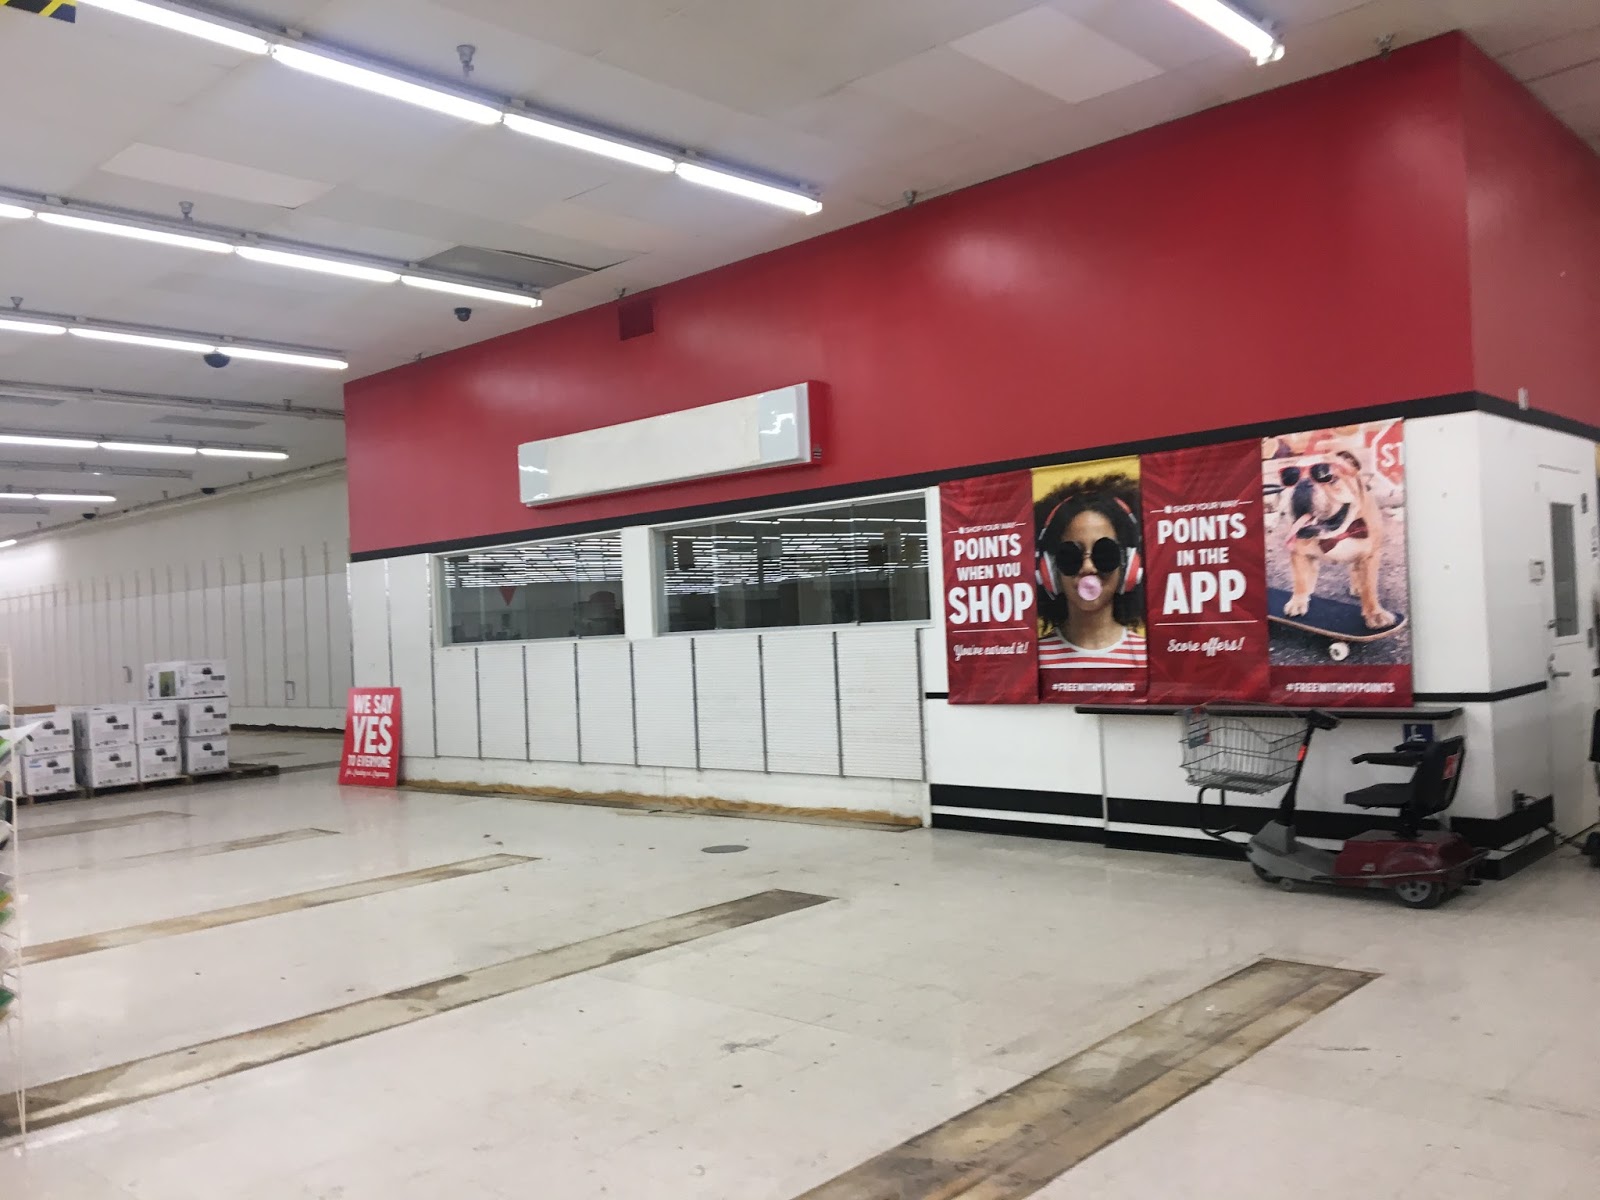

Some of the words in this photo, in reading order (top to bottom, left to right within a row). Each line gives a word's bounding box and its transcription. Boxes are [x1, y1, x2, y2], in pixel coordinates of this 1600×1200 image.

[1172, 504, 1195, 514] SHOP
[1195, 502, 1219, 511] YOUR
[1157, 512, 1247, 545] POINTS
[953, 533, 1022, 562] POINTS
[1177, 549, 1195, 567] IN
[1198, 546, 1230, 566] THE
[956, 564, 994, 581] WHEN
[996, 561, 1021, 578] YOU
[948, 582, 1034, 625] SHOP
[1162, 569, 1247, 615] APP
[1167, 638, 1200, 653] Score
[1200, 636, 1246, 657] offers!
[353, 694, 372, 714] WE
[373, 694, 394, 715] SAY
[352, 715, 393, 755] YES
